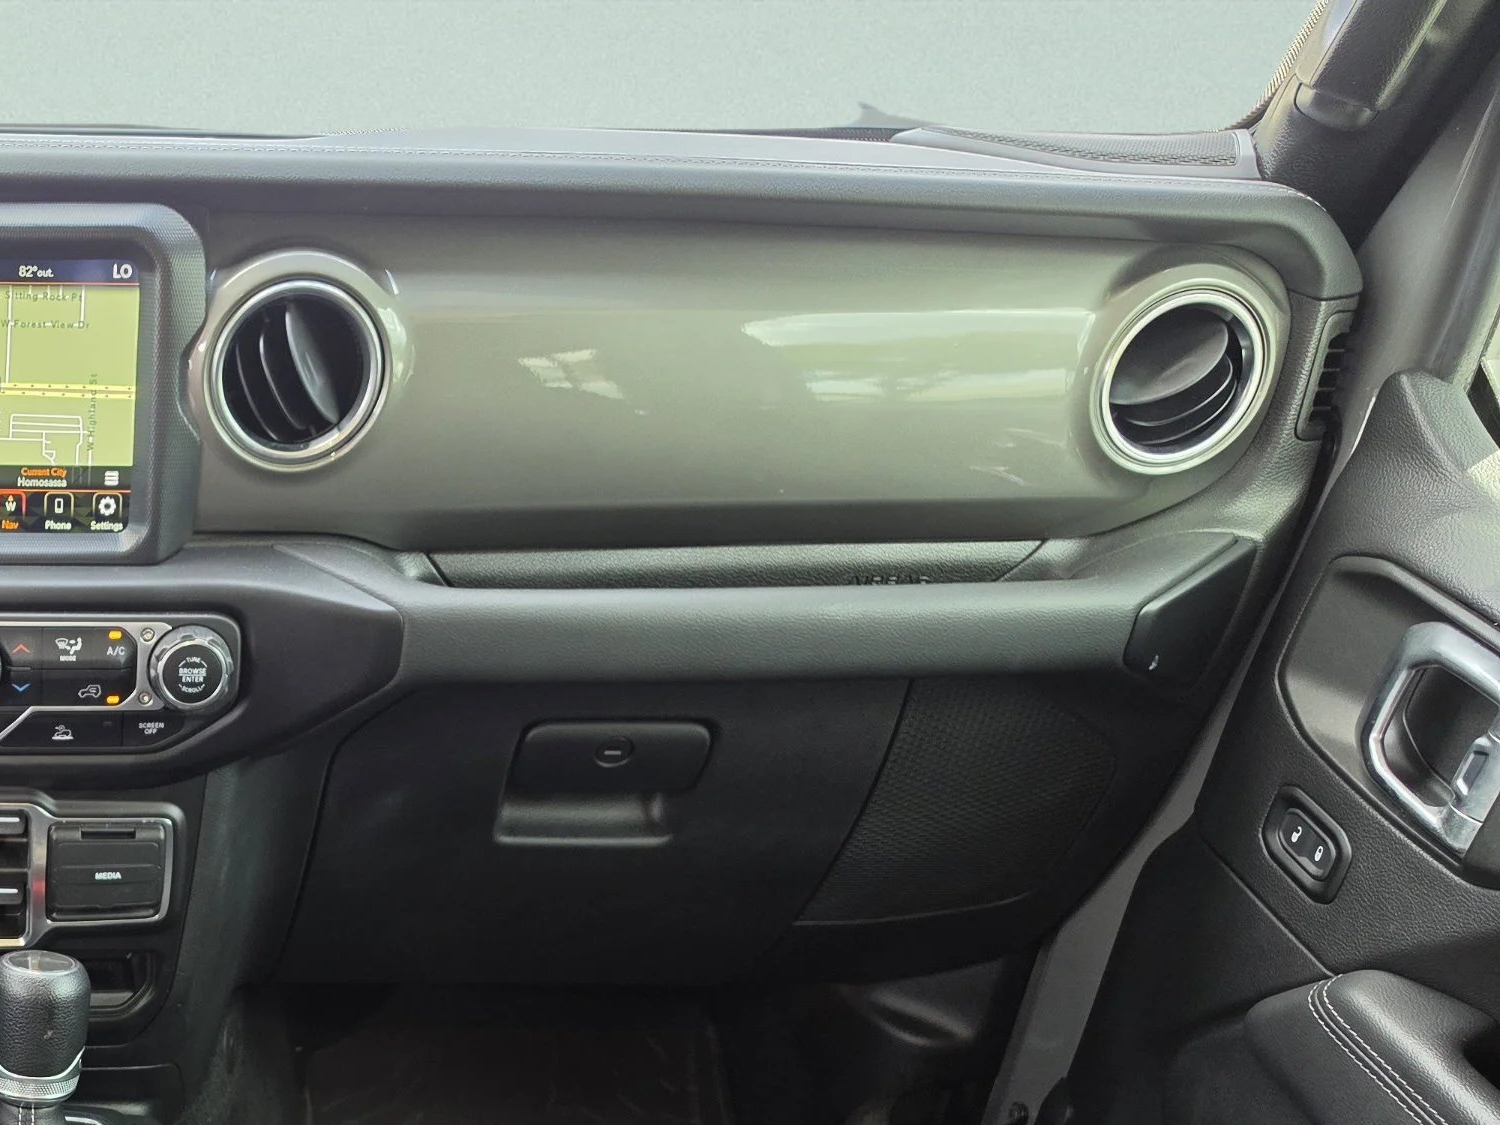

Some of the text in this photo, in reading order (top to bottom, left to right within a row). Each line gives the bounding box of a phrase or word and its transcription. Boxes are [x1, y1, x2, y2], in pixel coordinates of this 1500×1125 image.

[112, 263, 133, 279] LO
[20, 467, 67, 479] Current City
[17, 476, 67, 488] Homosassa
[1, 519, 19, 530] Nav
[44, 520, 72, 531] Phone
[90, 520, 123, 533] Settings
[106, 646, 126, 656] A/C
[178, 667, 207, 675] BROWSE
[138, 721, 164, 729] SCREEN
[94, 871, 122, 880] MEDIA
